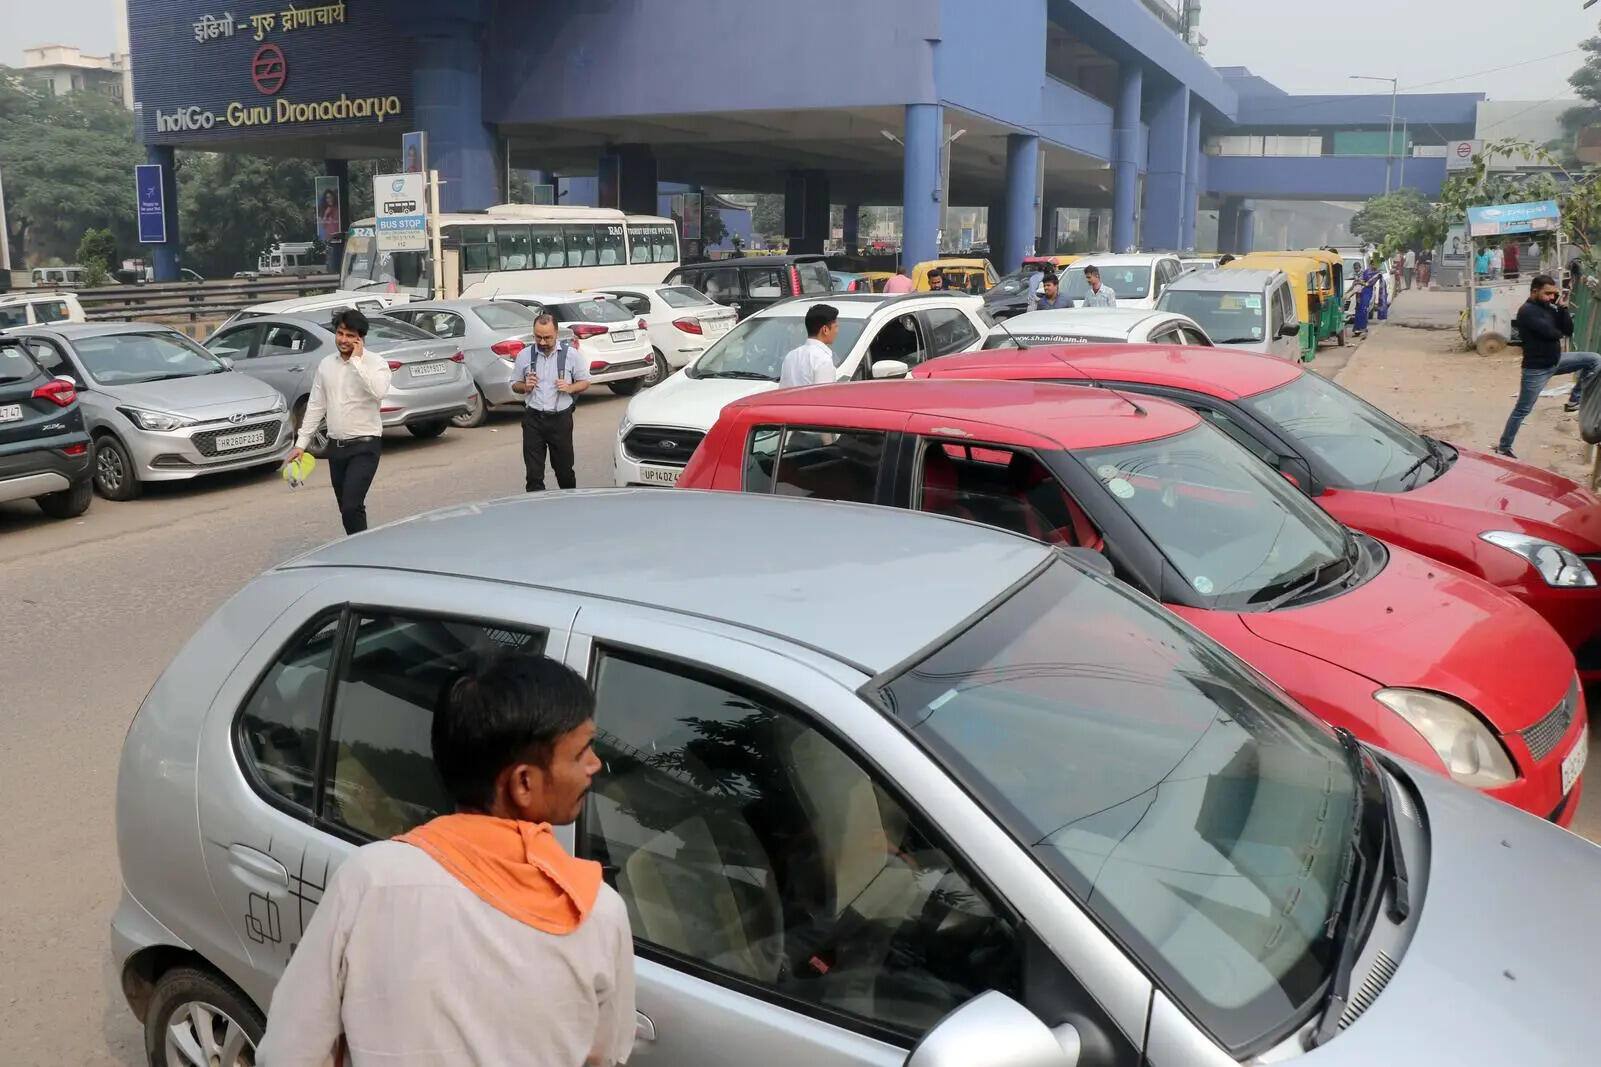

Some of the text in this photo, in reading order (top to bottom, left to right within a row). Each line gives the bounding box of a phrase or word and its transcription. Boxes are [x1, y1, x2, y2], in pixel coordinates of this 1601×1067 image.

[250, 13, 276, 41] गुरु
[280, 0, 345, 32] द्रोणाचार्य
[277, 94, 400, 122] Dronacharya
[380, 219, 420, 229] BUS STOP
[608, 226, 623, 235] RAO
